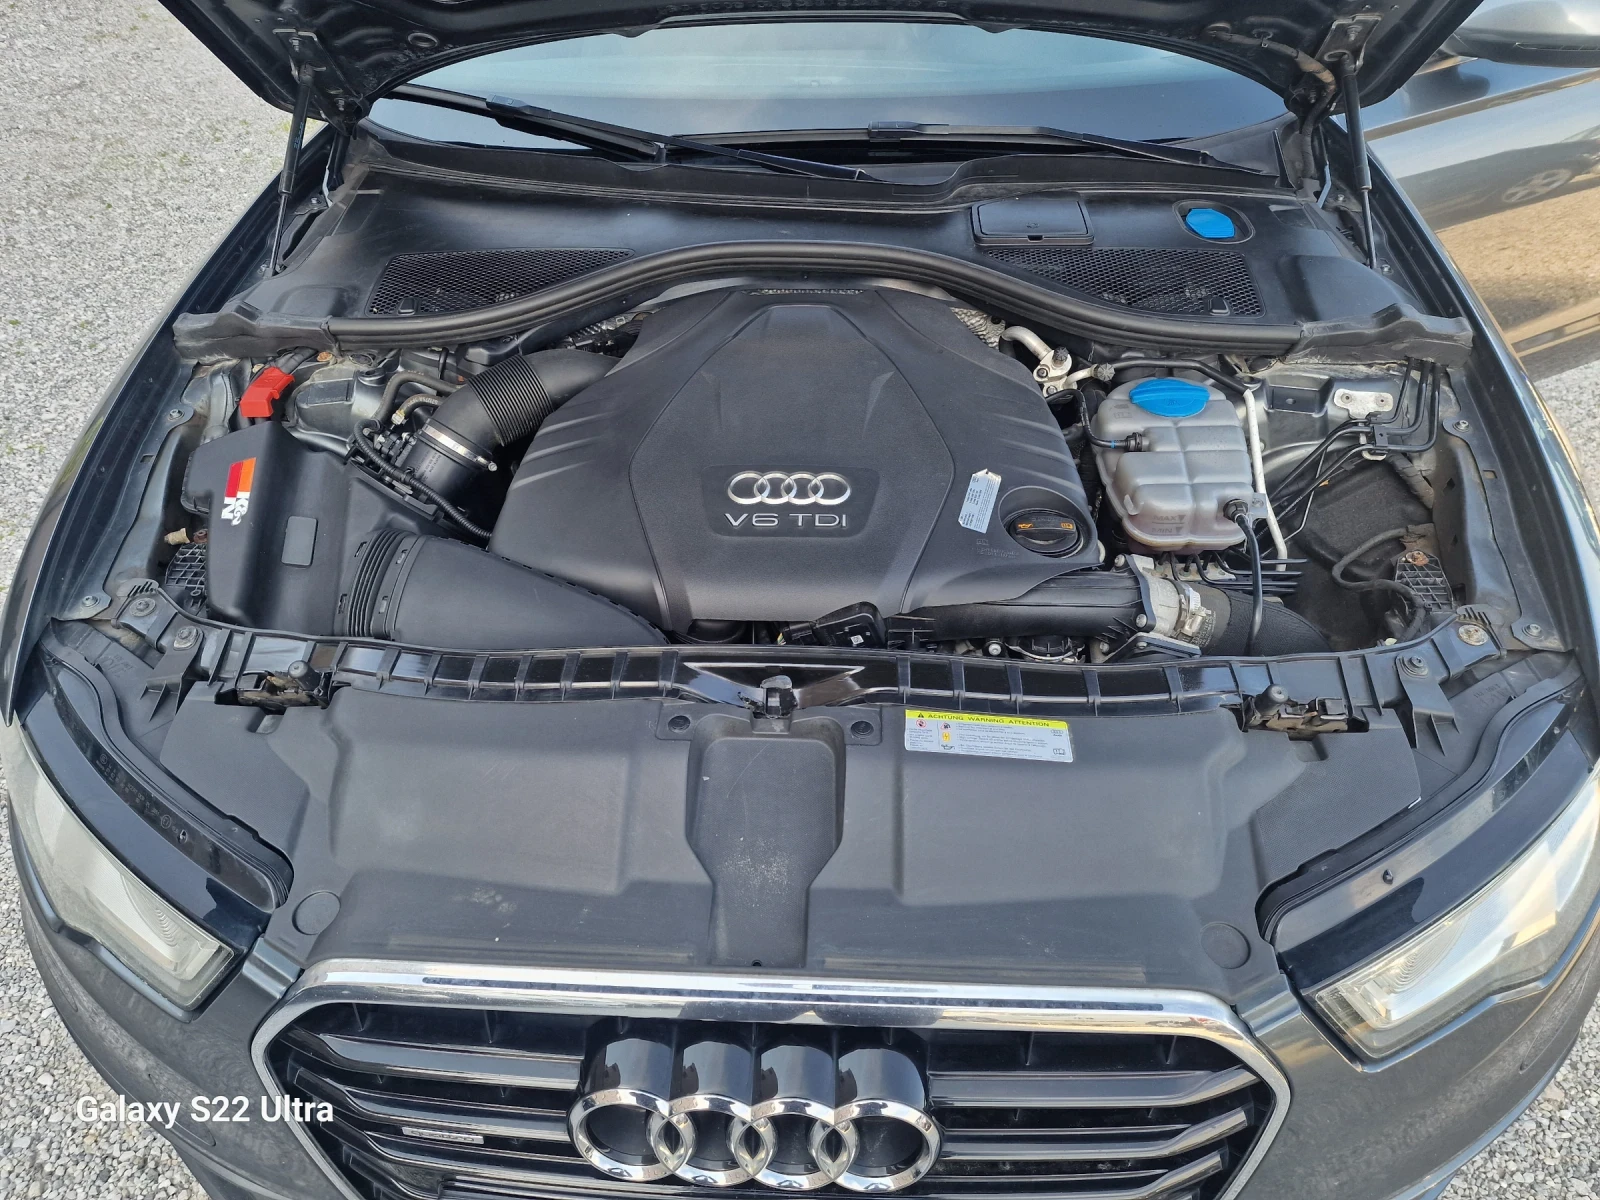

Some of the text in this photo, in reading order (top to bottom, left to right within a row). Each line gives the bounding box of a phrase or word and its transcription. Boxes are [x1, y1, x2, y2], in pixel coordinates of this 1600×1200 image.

[724, 513, 847, 527] V6 TDI
[927, 713, 1050, 727] ACHTUNG WARNING ATTENTION
